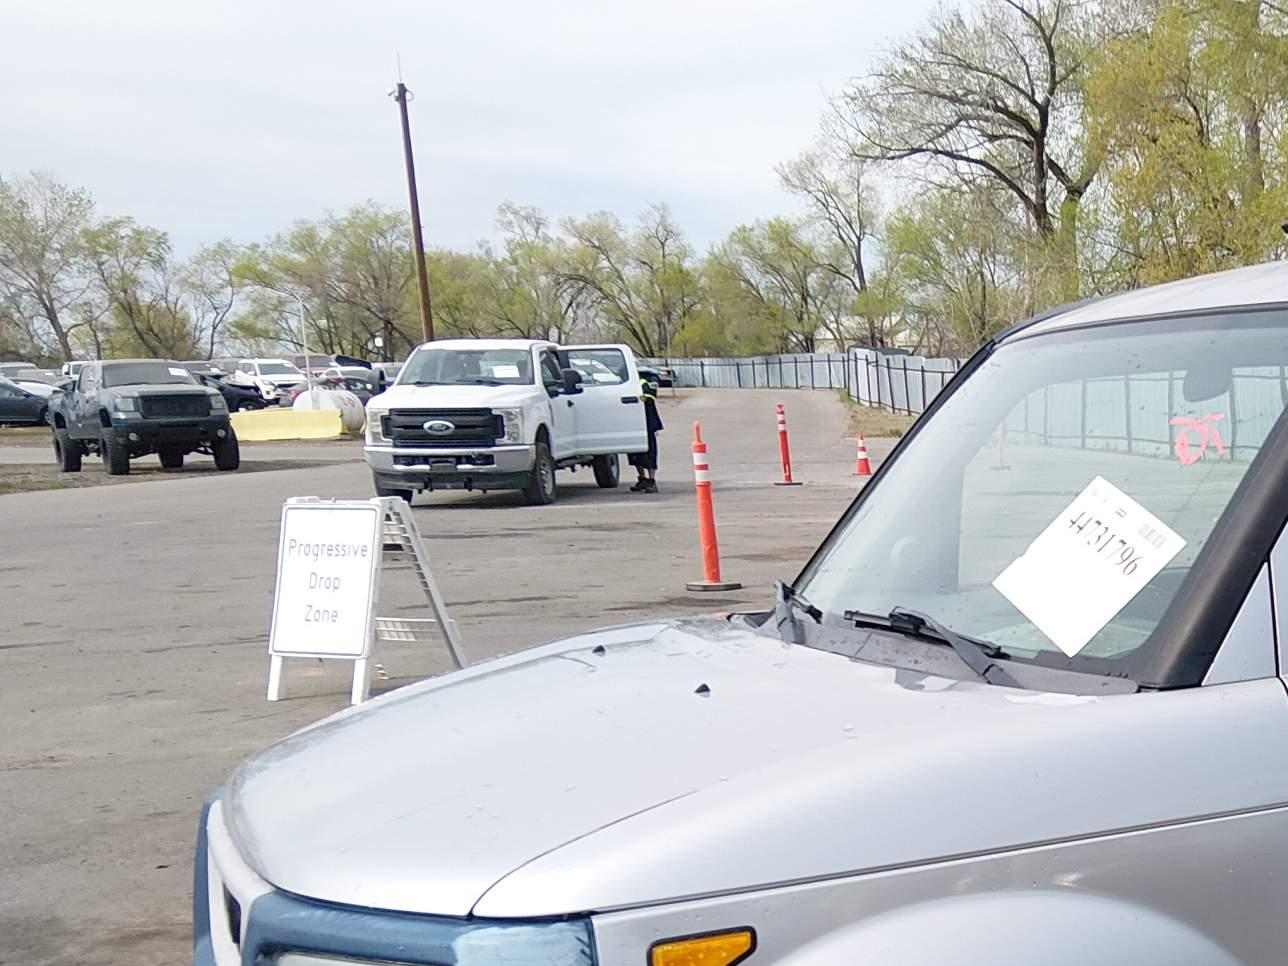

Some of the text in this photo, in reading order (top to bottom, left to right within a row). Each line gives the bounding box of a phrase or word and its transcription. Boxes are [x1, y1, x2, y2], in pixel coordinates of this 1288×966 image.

[288, 538, 368, 562] Progressive
[309, 571, 341, 593] Drop
[304, 604, 339, 623] Zone
